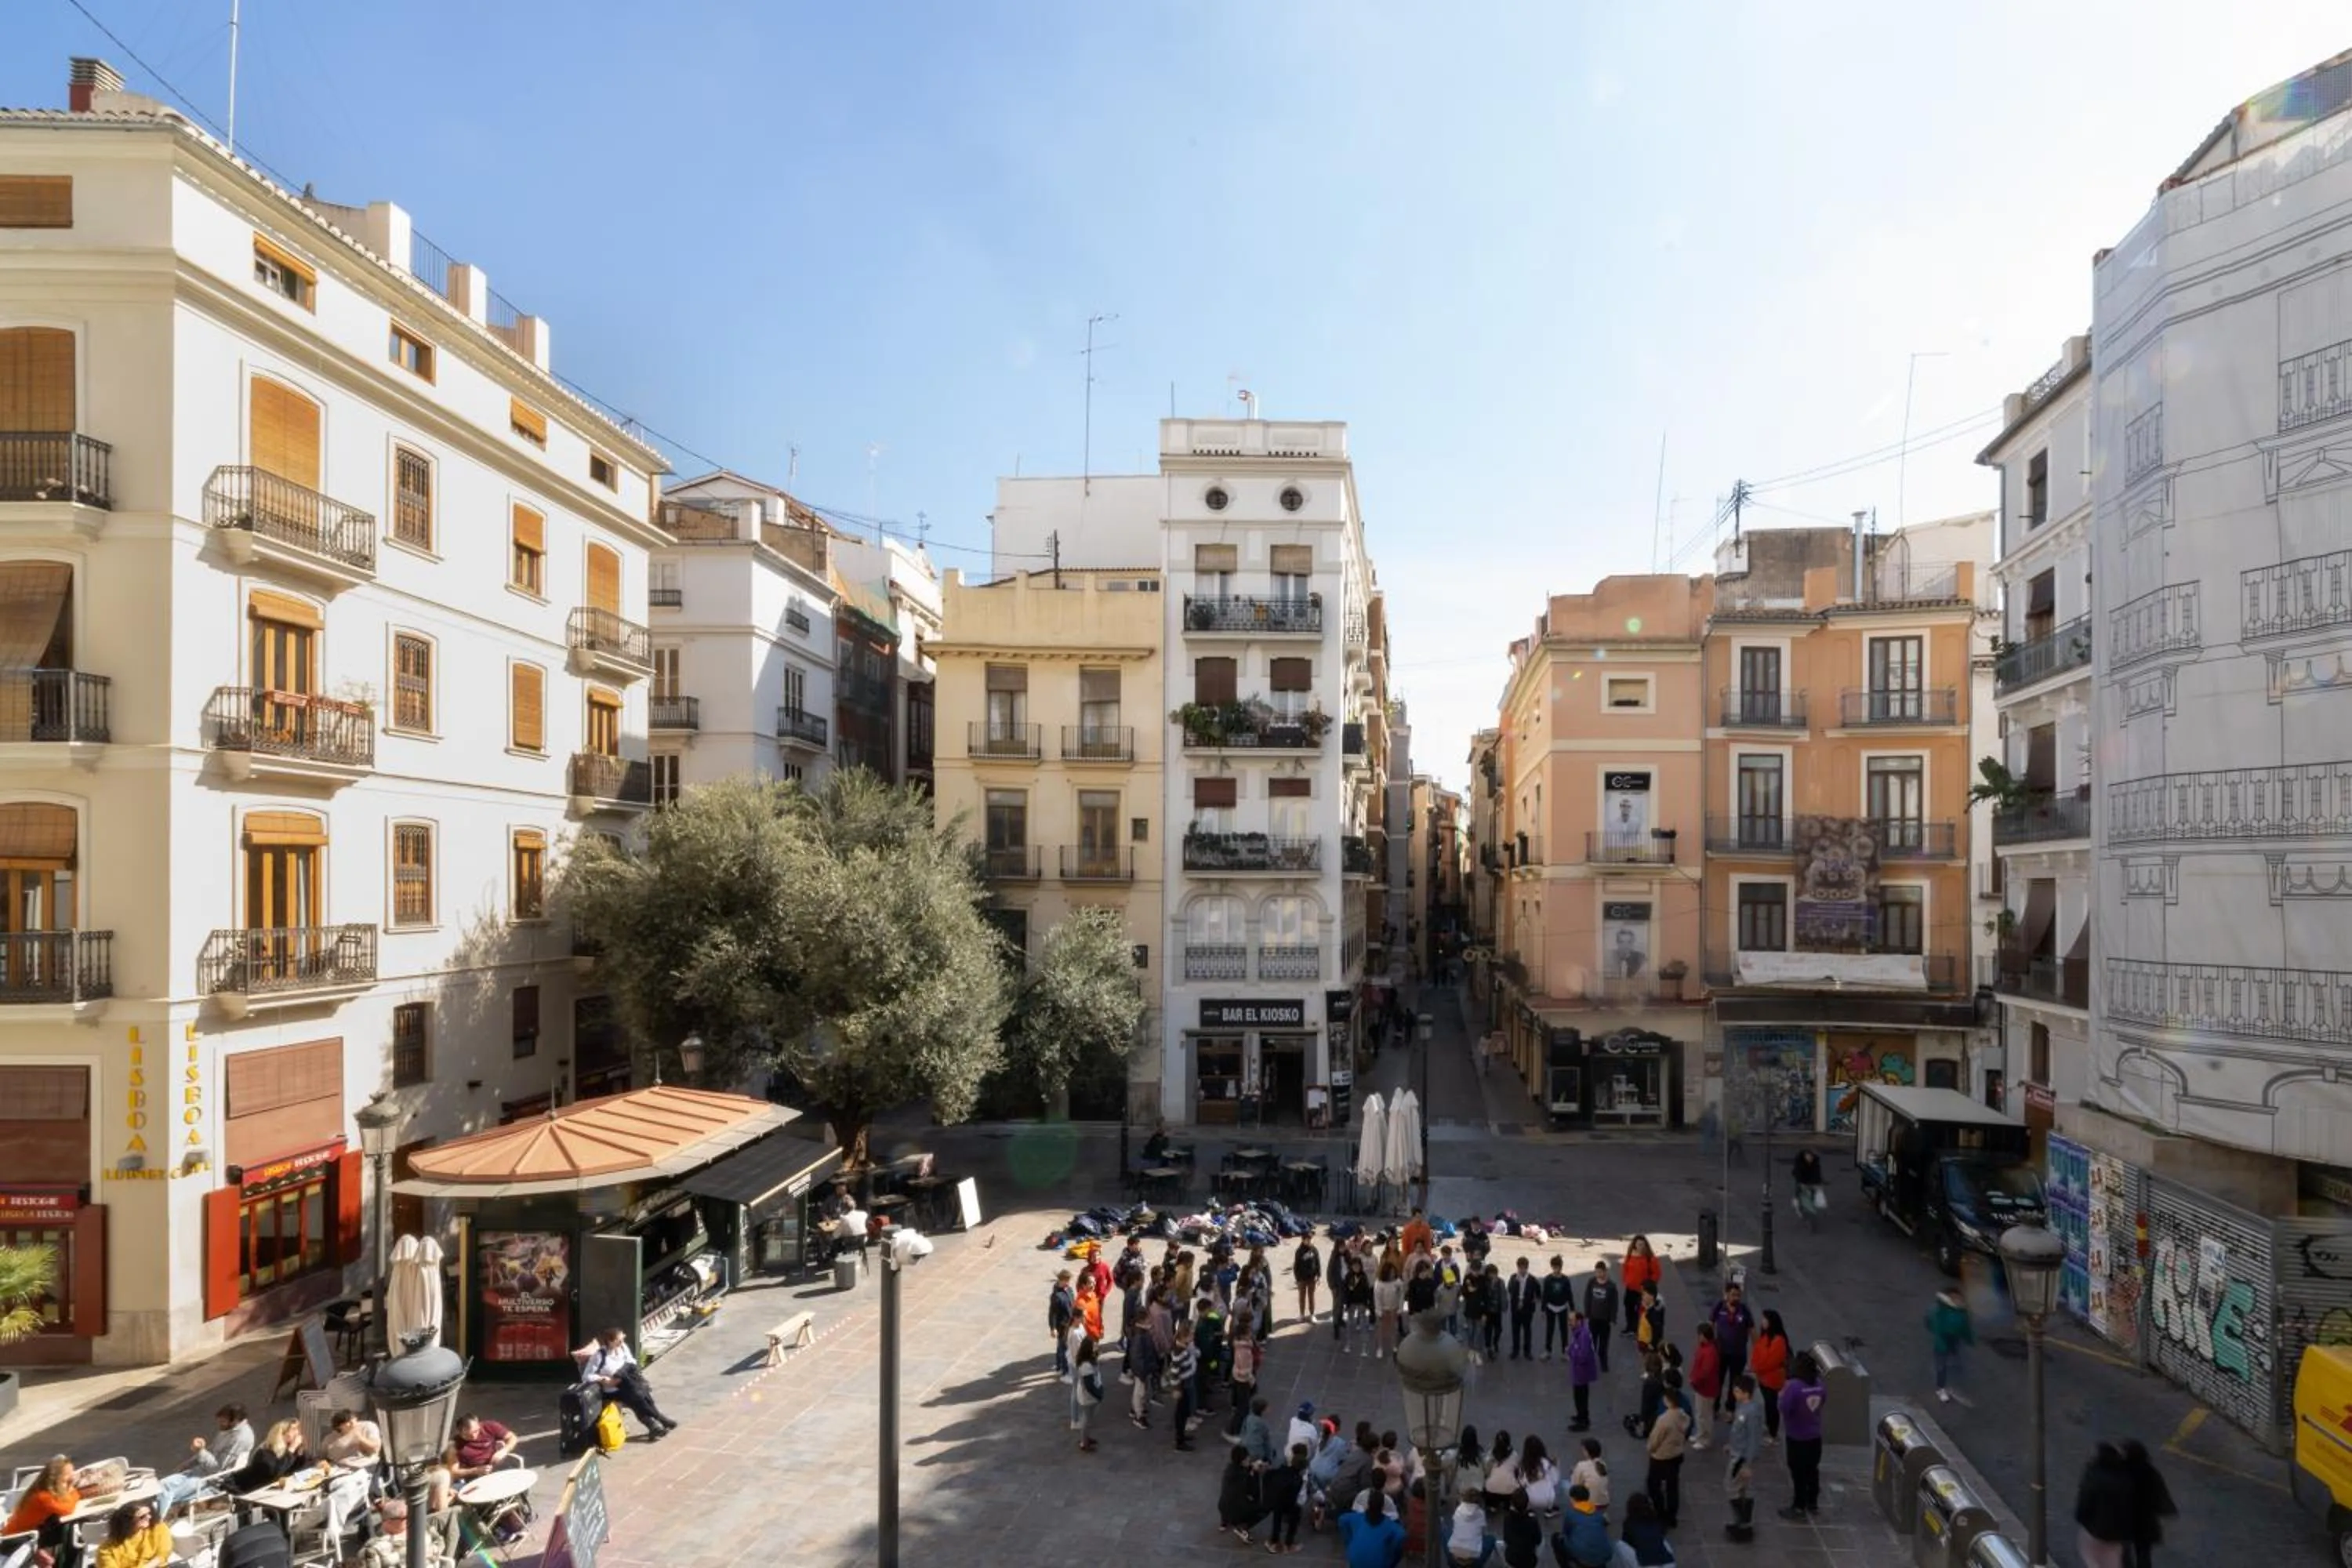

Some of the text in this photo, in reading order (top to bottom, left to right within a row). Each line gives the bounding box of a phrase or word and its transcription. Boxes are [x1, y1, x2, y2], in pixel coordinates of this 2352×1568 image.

[1222, 1007, 1243, 1022] BAR
[1245, 1007, 1258, 1022] EL
[1260, 1007, 1299, 1022] KIOSKO
[126, 1025, 147, 1152] LISBOA
[183, 1021, 201, 1145] LISBOA
